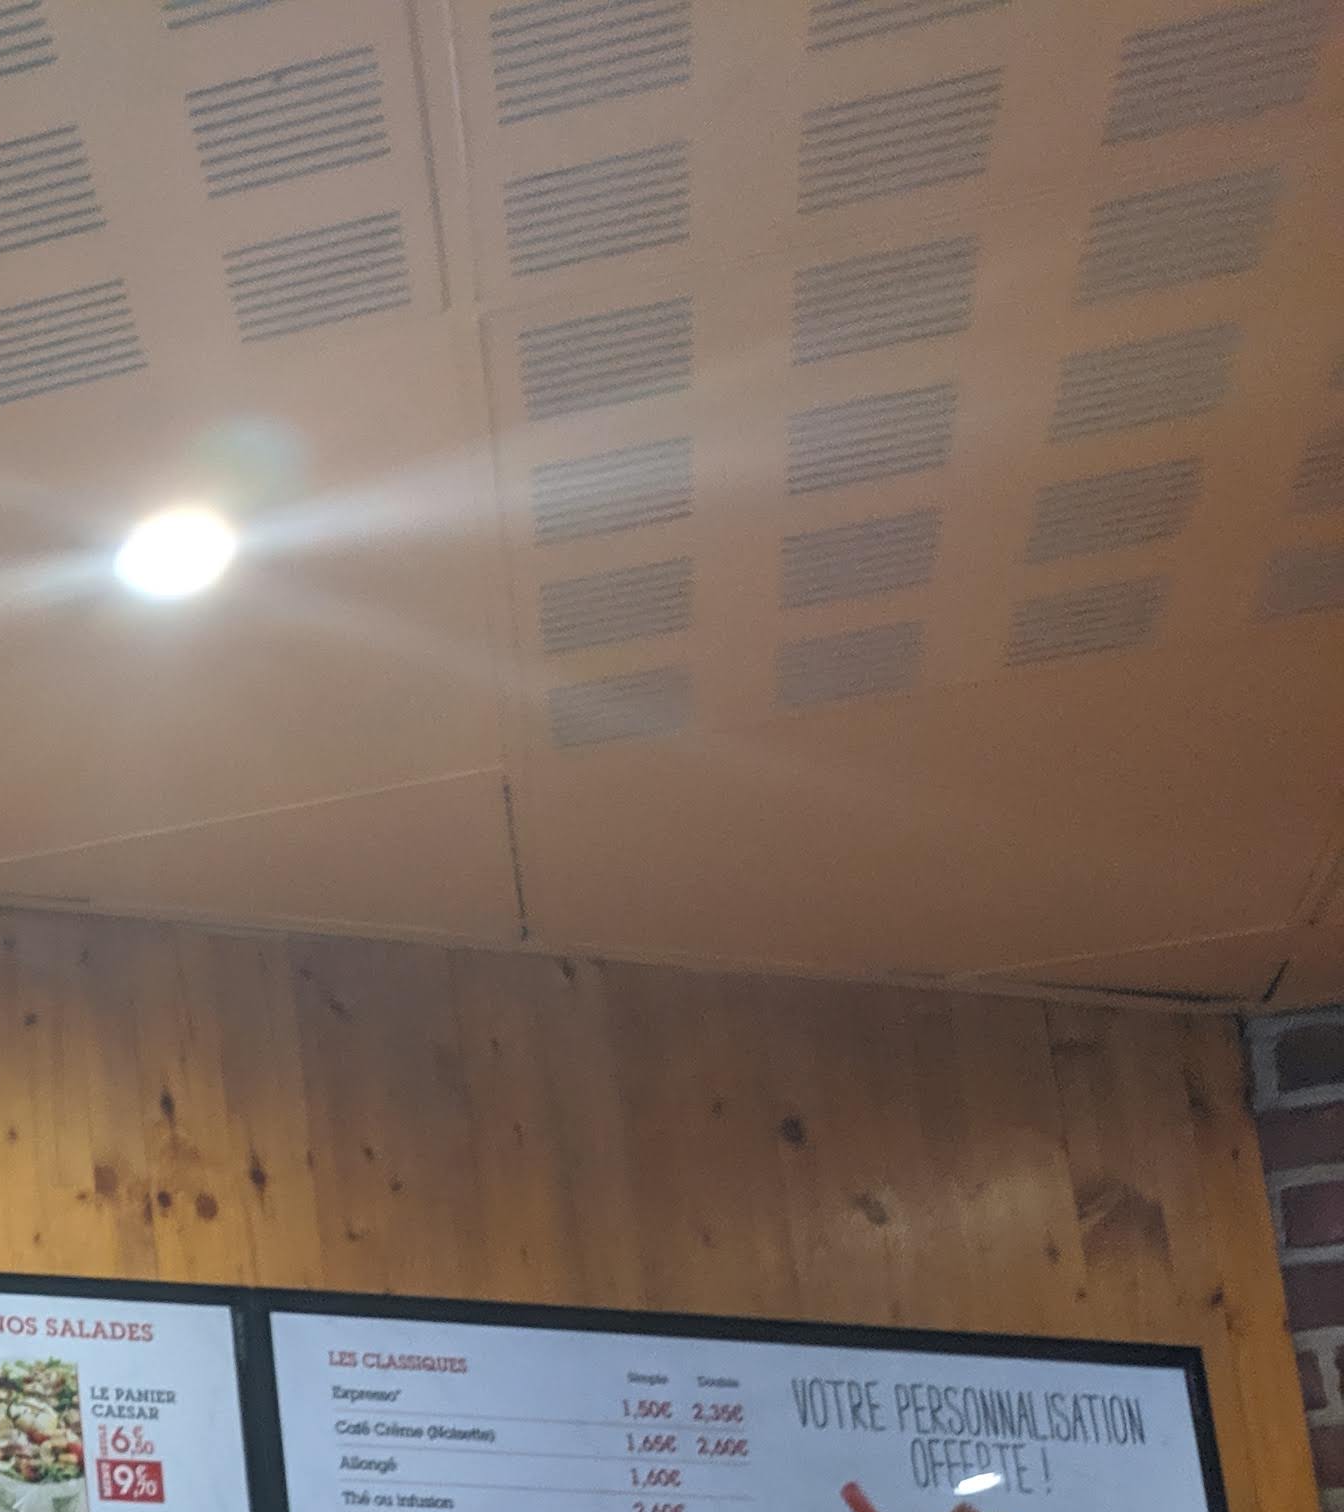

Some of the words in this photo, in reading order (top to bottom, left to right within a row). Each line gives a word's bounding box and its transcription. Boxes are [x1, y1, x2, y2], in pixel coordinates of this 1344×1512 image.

[46, 1317, 154, 1342] SALADES
[329, 1351, 357, 1367] LES
[362, 1353, 468, 1374] CLASSIQUES
[90, 1386, 111, 1401] LE
[115, 1388, 176, 1404] PANIER
[91, 1404, 159, 1420] CAESAR
[791, 1377, 885, 1432] VOTRE
[894, 1383, 1146, 1445] PERSONNALISATION
